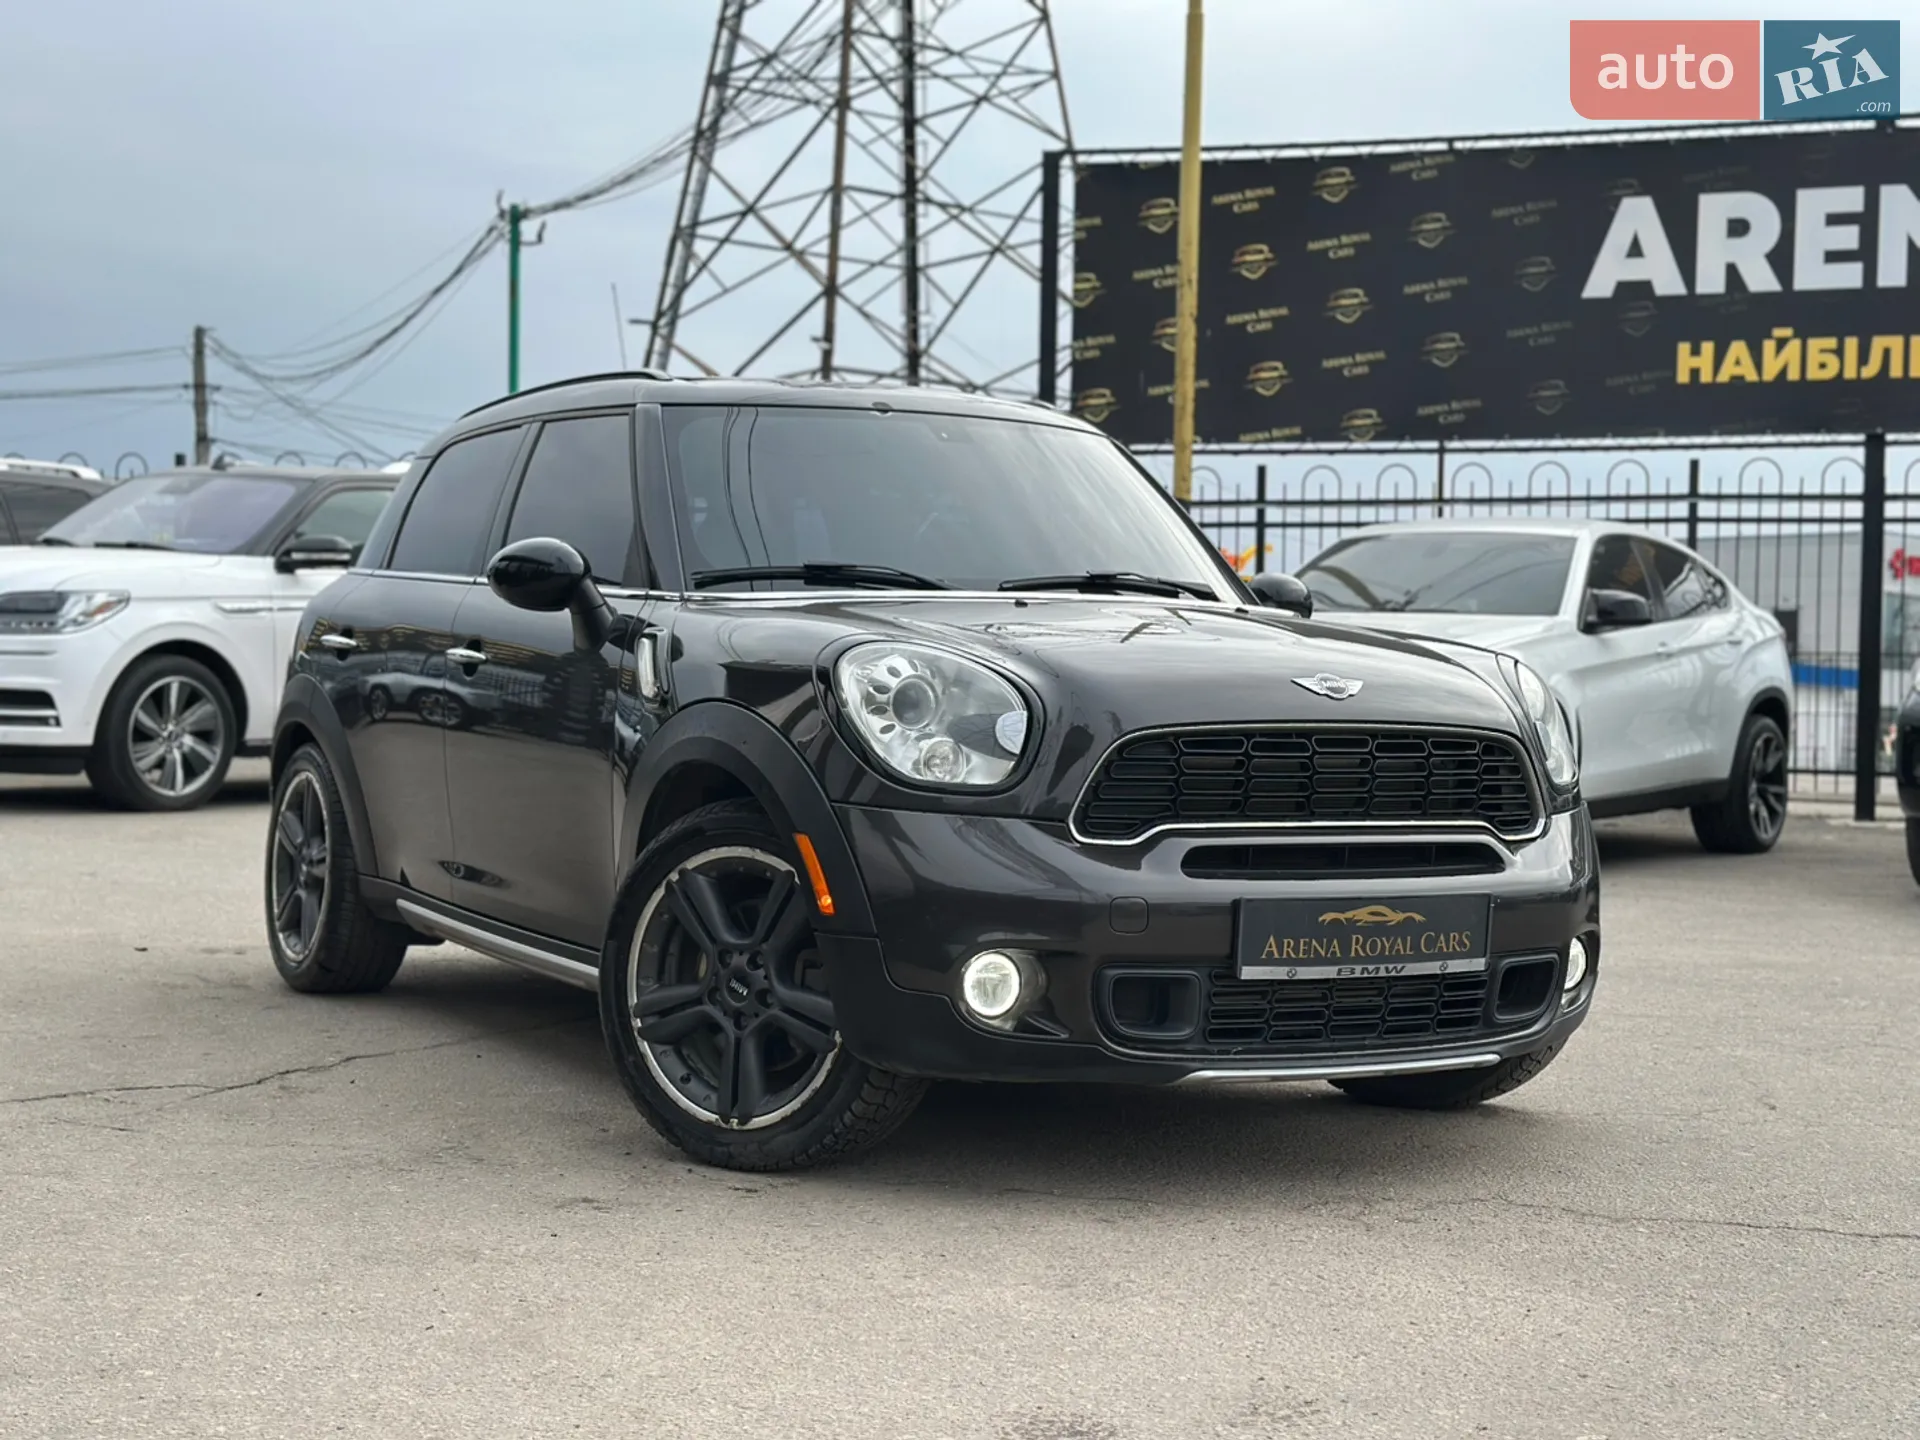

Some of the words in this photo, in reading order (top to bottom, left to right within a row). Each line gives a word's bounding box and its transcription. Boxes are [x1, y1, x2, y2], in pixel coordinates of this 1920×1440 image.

[1261, 934, 1341, 959] ARENA
[1350, 934, 1414, 957] ROYAL
[1420, 931, 1471, 954] CARS
[1336, 965, 1407, 977] BMW
